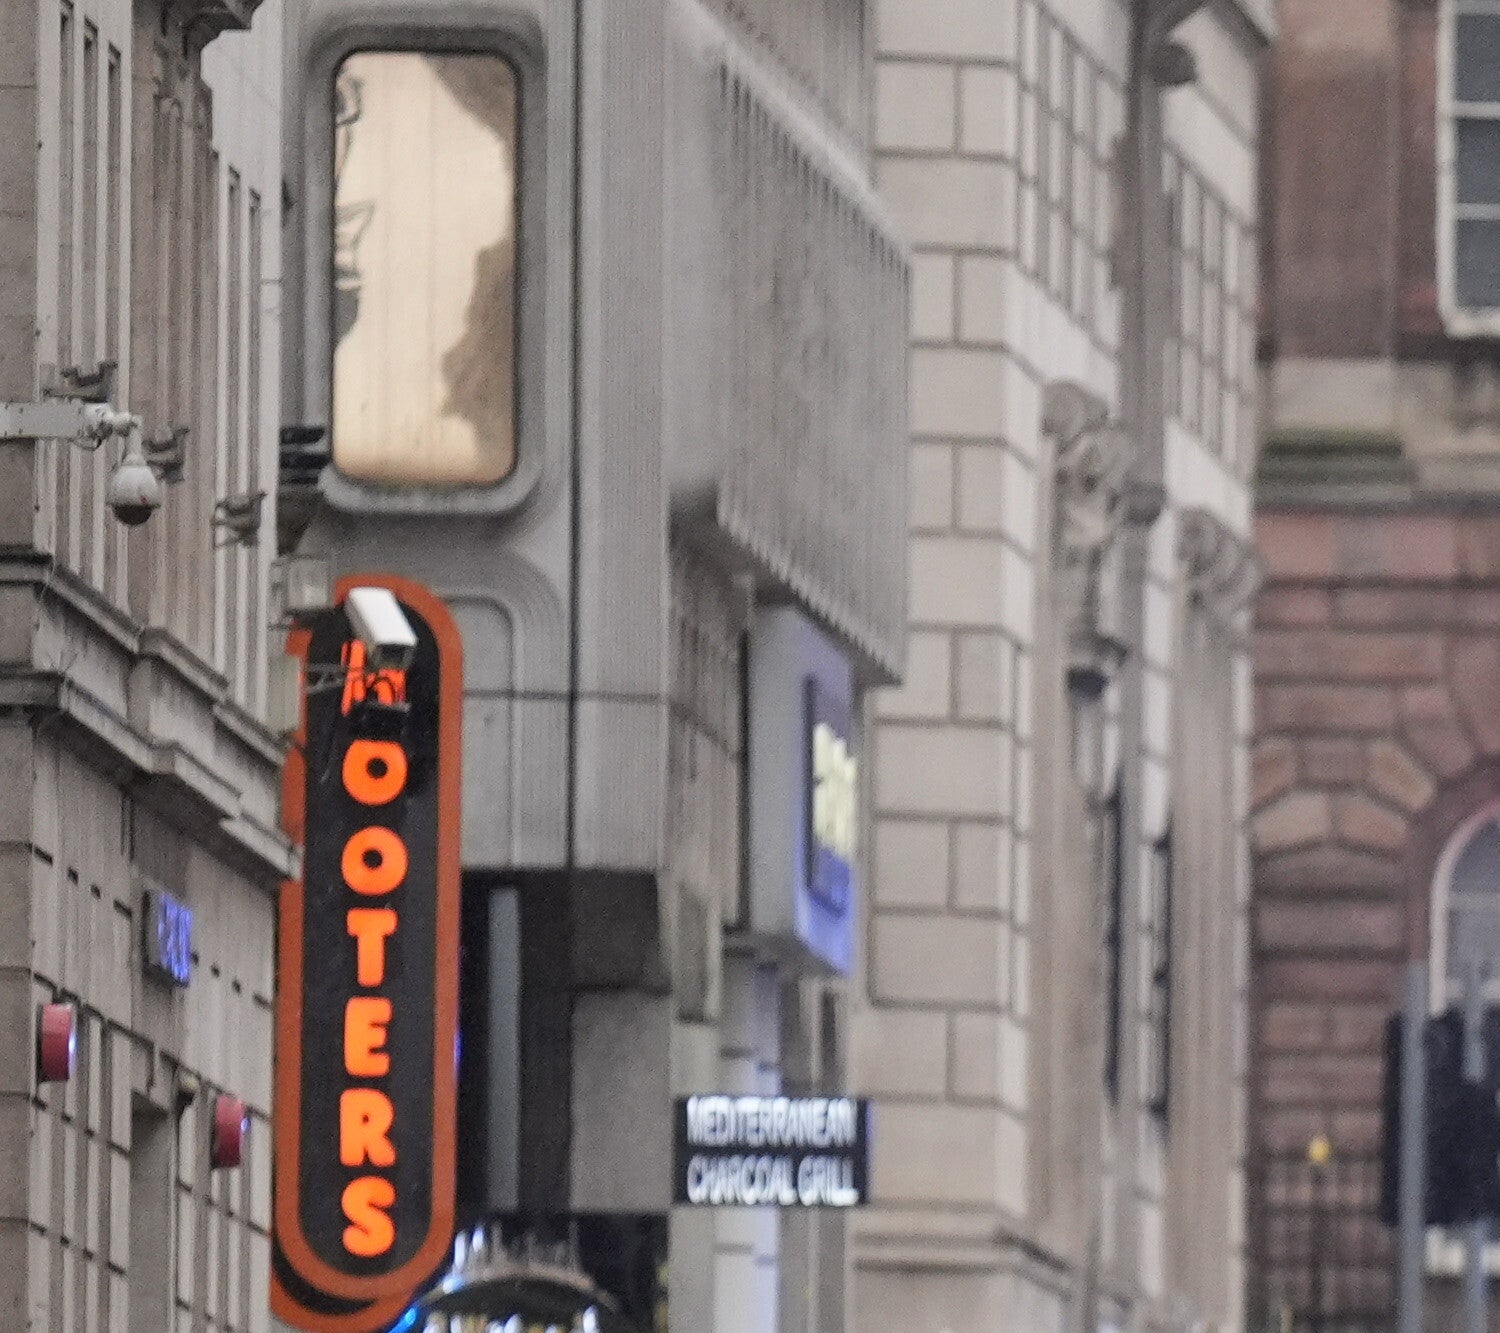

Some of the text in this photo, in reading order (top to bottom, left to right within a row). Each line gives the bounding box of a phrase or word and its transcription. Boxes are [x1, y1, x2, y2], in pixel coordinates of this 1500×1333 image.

[686, 1095, 859, 1147] MEDITERRANEAN
[686, 1154, 861, 1206] CHARCOAL GRILL
